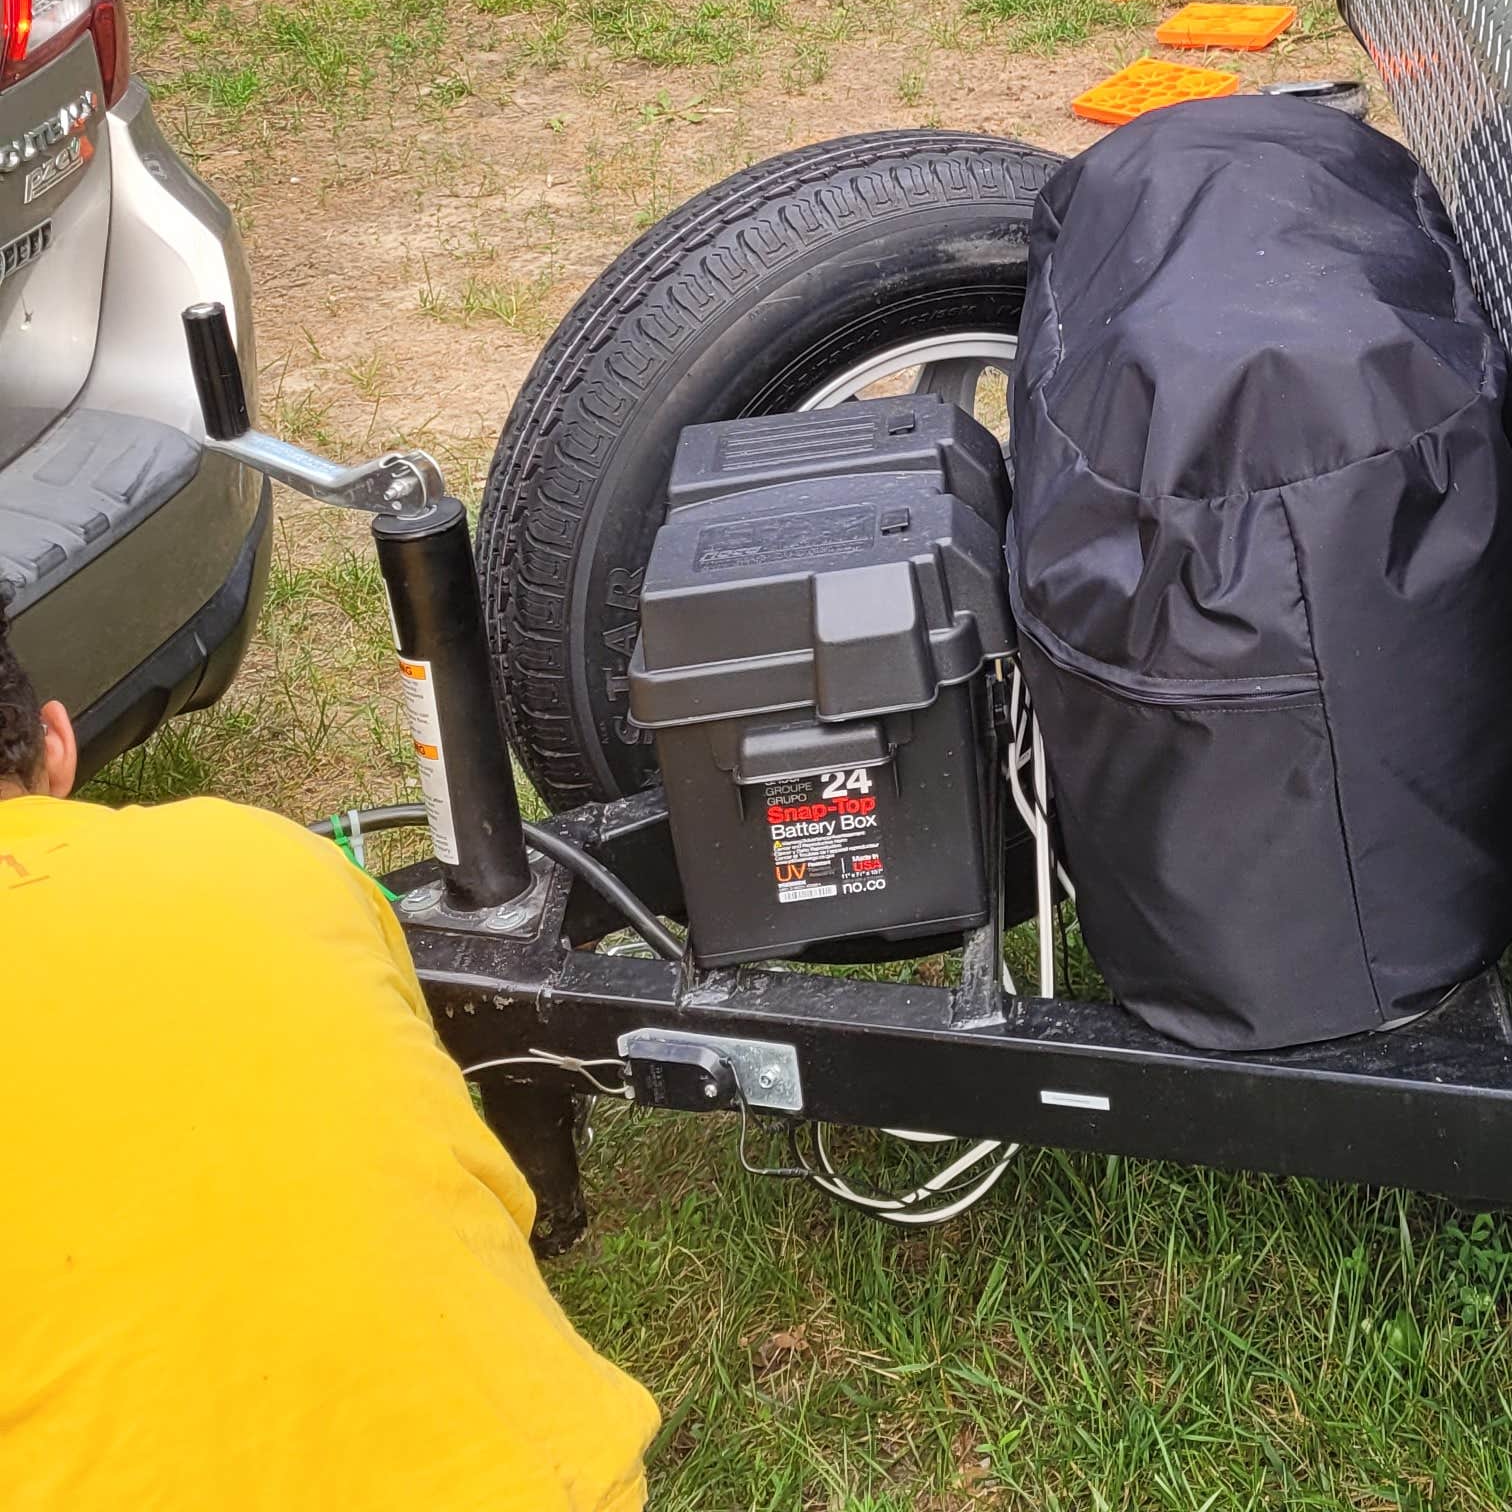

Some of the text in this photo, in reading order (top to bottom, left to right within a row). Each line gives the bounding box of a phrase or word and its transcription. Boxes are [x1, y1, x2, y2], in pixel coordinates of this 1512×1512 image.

[765, 781, 813, 797] GROUPE
[820, 768, 873, 799] 24
[766, 793, 808, 806] GRUPO
[767, 796, 877, 824] Snap-Top
[771, 820, 836, 840] Battery
[840, 814, 878, 830] Box
[775, 862, 807, 882] UV
[852, 859, 883, 872] USA
[842, 879, 887, 894] no.co
